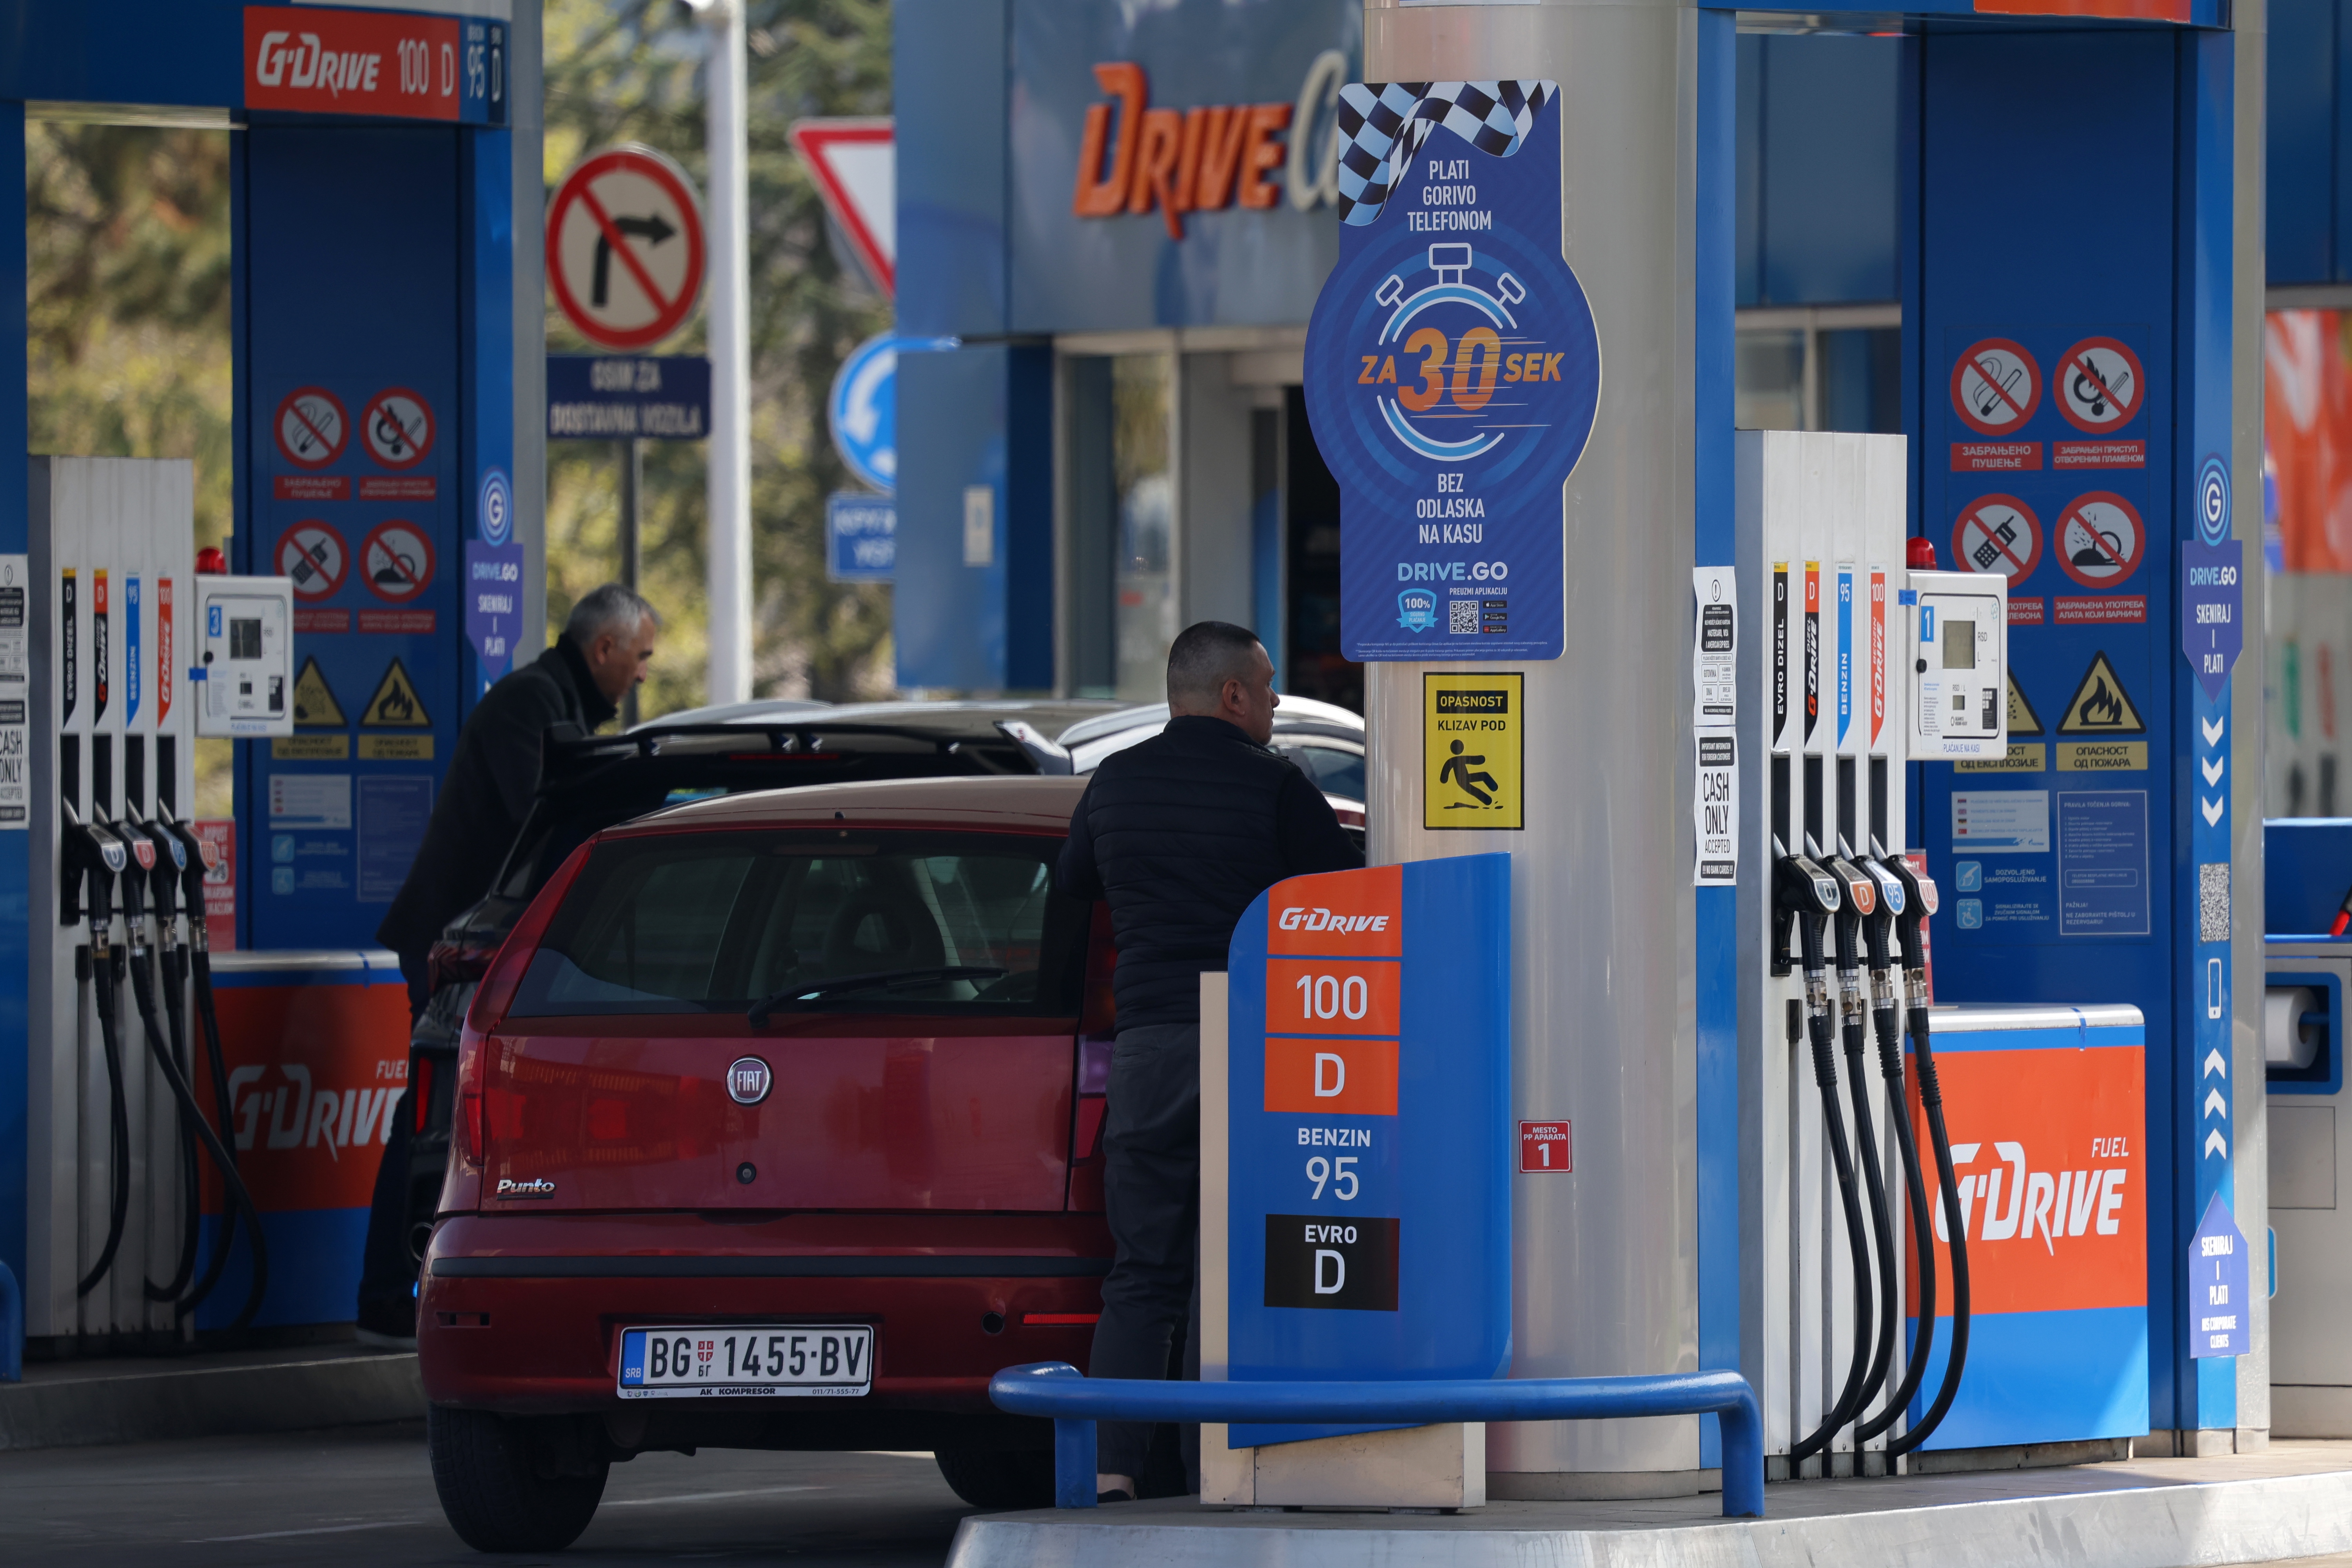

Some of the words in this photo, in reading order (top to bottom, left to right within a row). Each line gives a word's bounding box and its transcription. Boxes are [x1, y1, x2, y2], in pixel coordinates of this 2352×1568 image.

[398, 38, 429, 95] 100
[441, 42, 454, 97] D
[467, 44, 485, 99] 95
[491, 48, 501, 102] D
[1073, 61, 1294, 241] DRIVE
[1429, 160, 1469, 180] PLATI
[1423, 186, 1476, 205] GORIVO
[1407, 211, 1492, 231] TELEFONOM
[1357, 355, 1397, 384] ZA
[1397, 327, 1501, 411] 30
[1503, 353, 1565, 382] SEK
[1963, 446, 2031, 456] ЗАБРАЊЕНО
[2102, 455, 2144, 463] ПЛАМЕНОМ
[1972, 458, 2022, 468] ПУШЕЊЕ
[1438, 473, 1463, 493] BEZ
[488, 492, 503, 526] G
[1416, 498, 1485, 518] ODLASKA
[2206, 483, 2221, 522] G
[1419, 524, 1439, 544] NA
[1443, 524, 1482, 543] KASU
[1398, 561, 1508, 581] DRIVE.GO
[2190, 566, 2237, 585] DRIVE.GO
[66, 584, 73, 603] D
[1450, 587, 1474, 595] PREUZMI
[1778, 583, 1784, 601] D
[1809, 581, 1815, 600] D
[1840, 583, 1850, 602] 95
[1872, 583, 1884, 602] 100
[1405, 598, 1430, 608] 100%
[2056, 602, 2103, 610] ЗАБРАЊЕНА
[2105, 601, 2144, 609] УПОТРЕБА
[211, 608, 220, 635] 3
[2106, 610, 2141, 618] ВАРНИЧИ
[2196, 604, 2231, 623] SKENIRAJ
[1925, 610, 1931, 639] 1
[1707, 641, 1719, 649] AMERICAN
[1977, 632, 1987, 642] RSD
[2212, 628, 2215, 648] I
[1977, 651, 1980, 662] L
[2204, 654, 2223, 673] PLATI
[1704, 669, 1717, 678] GOTOVINA
[1440, 696, 1503, 707] OPASNOST
[1438, 720, 1477, 731] KLIZAV
[1481, 720, 1506, 731] POD
[1943, 741, 1963, 753] PLAĆANJE
[1964, 743, 1970, 753] NA
[1971, 743, 1980, 753] KASI
[2076, 746, 2129, 756] ОПАСНОСТ
[1960, 759, 1975, 770] ОД
[2074, 759, 2089, 769] ОД
[2091, 757, 2131, 768] ПОЖАРА
[1703, 772, 1729, 802] CASH
[1705, 805, 1729, 835] ONLY
[1705, 839, 1730, 853] ACCEPTED
[1706, 865, 1711, 874] NO
[1719, 865, 1729, 874] CARDS
[1822, 882, 1833, 901] D
[1859, 887, 1870, 906] D
[1888, 885, 1901, 904] 95
[1922, 882, 1936, 902] 100
[1297, 975, 1367, 1020] 100
[376, 1060, 408, 1079] FUE
[1315, 1053, 1345, 1097] D
[737, 1070, 762, 1092] FIAT
[1298, 1128, 1370, 1147] BENZIN
[1538, 1143, 1549, 1167] 1
[2092, 1137, 2129, 1158] FUEL
[496, 1178, 556, 1194] Punto
[1306, 1156, 1359, 1201] 95
[1305, 1225, 1357, 1244] EVRO
[2201, 1235, 2233, 1257] SKENIRAJ
[1315, 1249, 1345, 1294] D
[2216, 1260, 2220, 1280] I
[2209, 1285, 2228, 1306] PLATI
[2201, 1317, 2210, 1332] NIS
[2210, 1315, 2236, 1331] CORPORATE
[2210, 1334, 2229, 1348] CLIENTS
[625, 1368, 641, 1378] SRB
[651, 1337, 691, 1378] BG
[718, 1387, 776, 1396] KOMPRESOR
